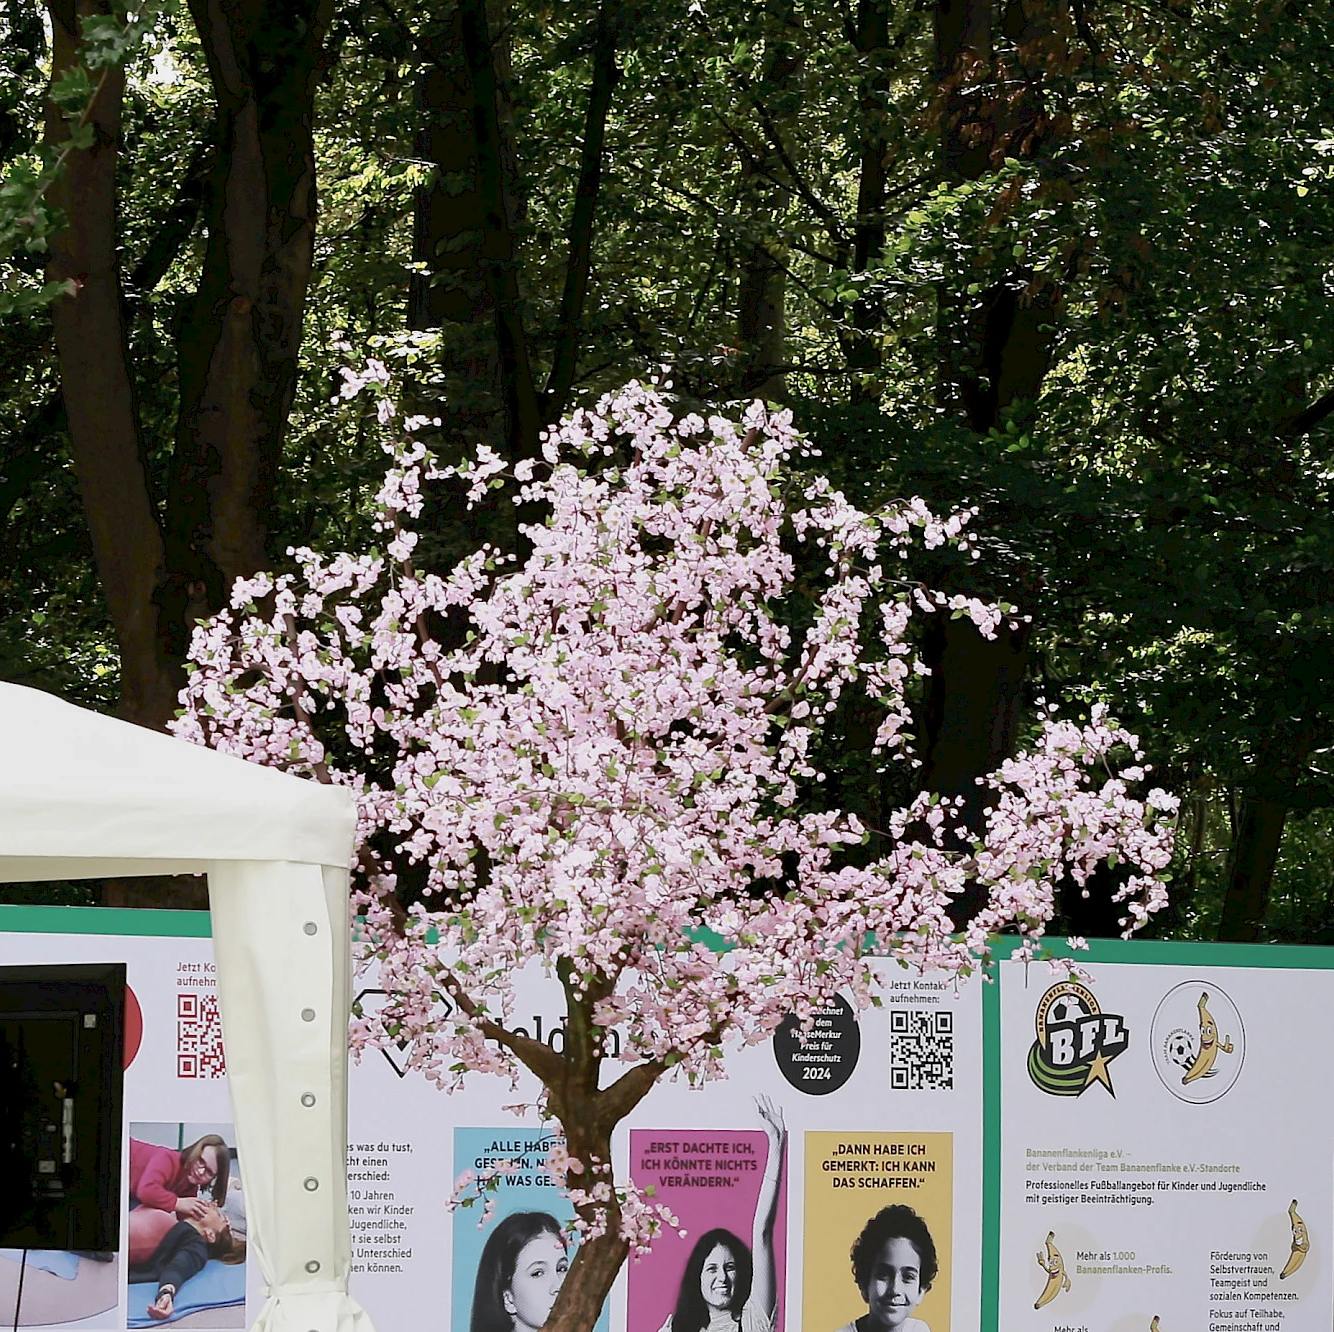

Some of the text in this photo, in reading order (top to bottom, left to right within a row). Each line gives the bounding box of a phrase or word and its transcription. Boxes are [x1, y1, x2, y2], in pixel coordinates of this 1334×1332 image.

[177, 961, 201, 973] Jetzt
[890, 981, 910, 989] Jetzt
[890, 994, 939, 1003] aufnehmen:
[815, 1018, 832, 1027] dem
[821, 1042, 833, 1050] für
[1050, 1019, 1124, 1065] BFL
[791, 1053, 841, 1063] Kinderschutz
[802, 1067, 831, 1080] 2024
[356, 1142, 413, 1154] was du tust,
[484, 1141, 521, 1153] „ALLE
[644, 1142, 755, 1155] „ERST DACHTE ICH,
[833, 1144, 925, 1156] „DANN HABE ICH
[1026, 1148, 1108, 1160] Bananenflankenliga
[362, 1157, 388, 1167] einen
[641, 1157, 757, 1171] ICH KÖNNTE NICHTS
[823, 1161, 935, 1171] GEMERKT: ICH KANN
[1042, 1162, 1077, 1172] Verband
[1080, 1163, 1093, 1172] der
[1095, 1163, 1118, 1172] Team
[1120, 1163, 1181, 1173] Bananenflanke
[505, 1176, 531, 1187] WAS
[659, 1173, 739, 1188] VERÄNDERN.“
[834, 1178, 924, 1188] DAS SCHAFFEN.“
[1026, 1180, 1265, 1192] Professionelles Fußballangebot für Kinder und Jugendliche
[350, 1190, 394, 1201] 10 Jahren
[1026, 1194, 1154, 1205] mit geistiger Beeinträchtigung.
[366, 1205, 414, 1215] wir Kinder
[350, 1219, 407, 1231] Jugendliche,
[359, 1233, 401, 1244] sie selbst
[357, 1248, 412, 1258] Unterschied
[1077, 1251, 1135, 1261] Mehr als 1.000
[1211, 1252, 1251, 1262] Förderung
[367, 1263, 403, 1273] können.
[1077, 1265, 1172, 1275] Bananenflanken-Profis.
[1211, 1265, 1274, 1274] Selbstvertrauen,
[1210, 1278, 1267, 1289] Teamgeist und
[1210, 1292, 1298, 1301] sozialen Kompetenzen.
[1209, 1322, 1279, 1331] Gemeinschaft und
